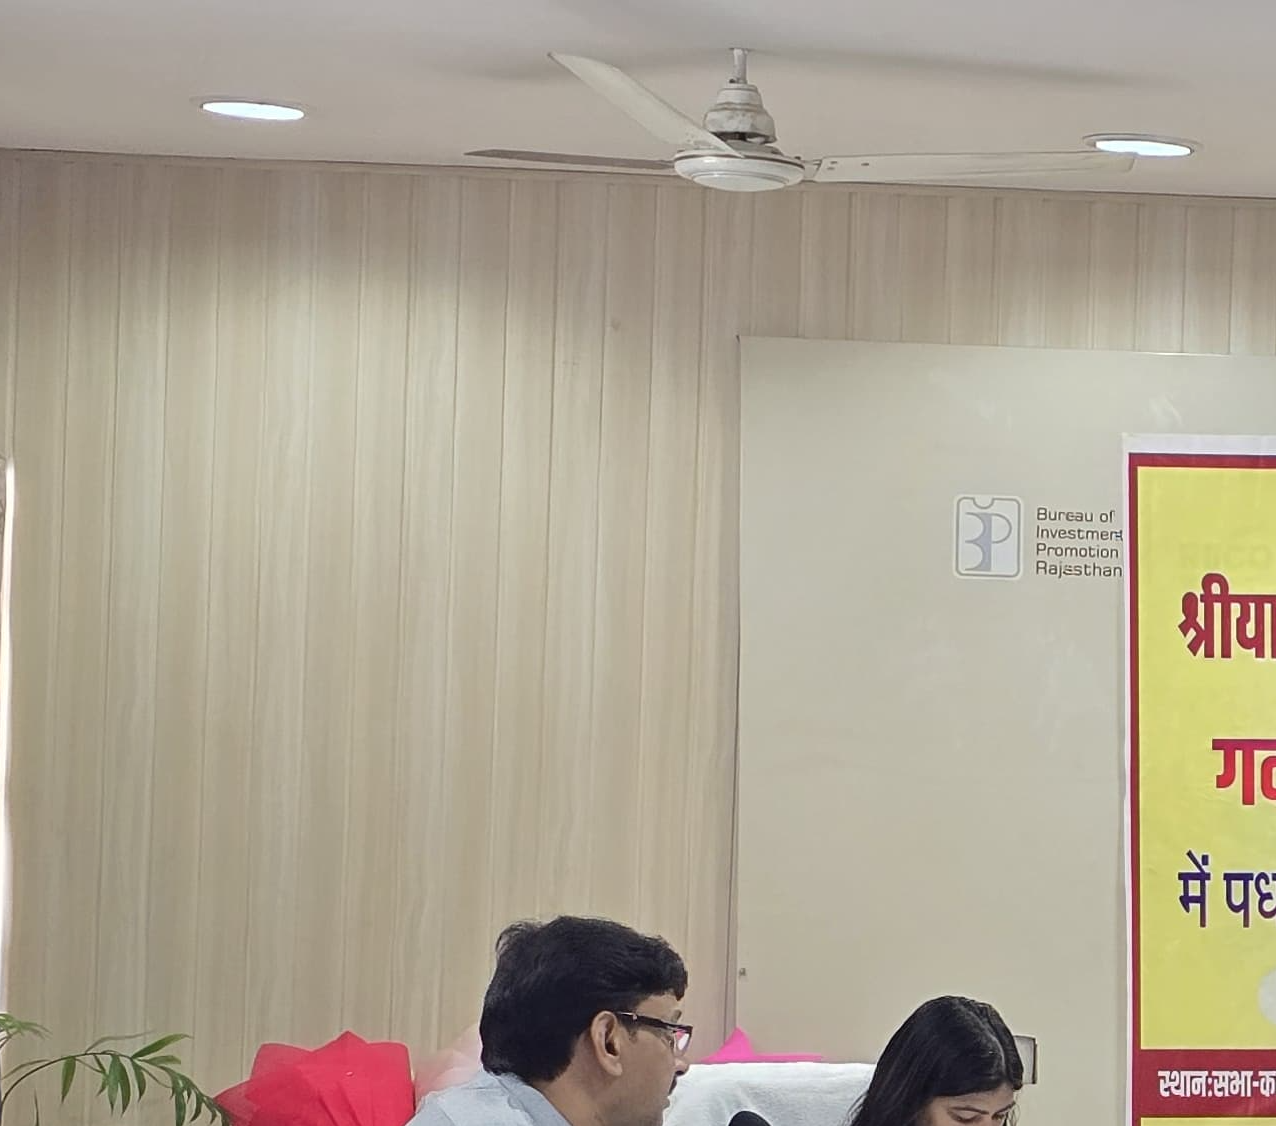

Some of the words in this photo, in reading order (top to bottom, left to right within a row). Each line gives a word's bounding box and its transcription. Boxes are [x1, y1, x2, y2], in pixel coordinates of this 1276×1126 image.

[1036, 507, 1093, 522] Bureau
[1099, 510, 1115, 523] of
[1036, 543, 1119, 559] Promotion
[1036, 560, 1123, 579] Rajasthan
[1178, 850, 1211, 929] में
